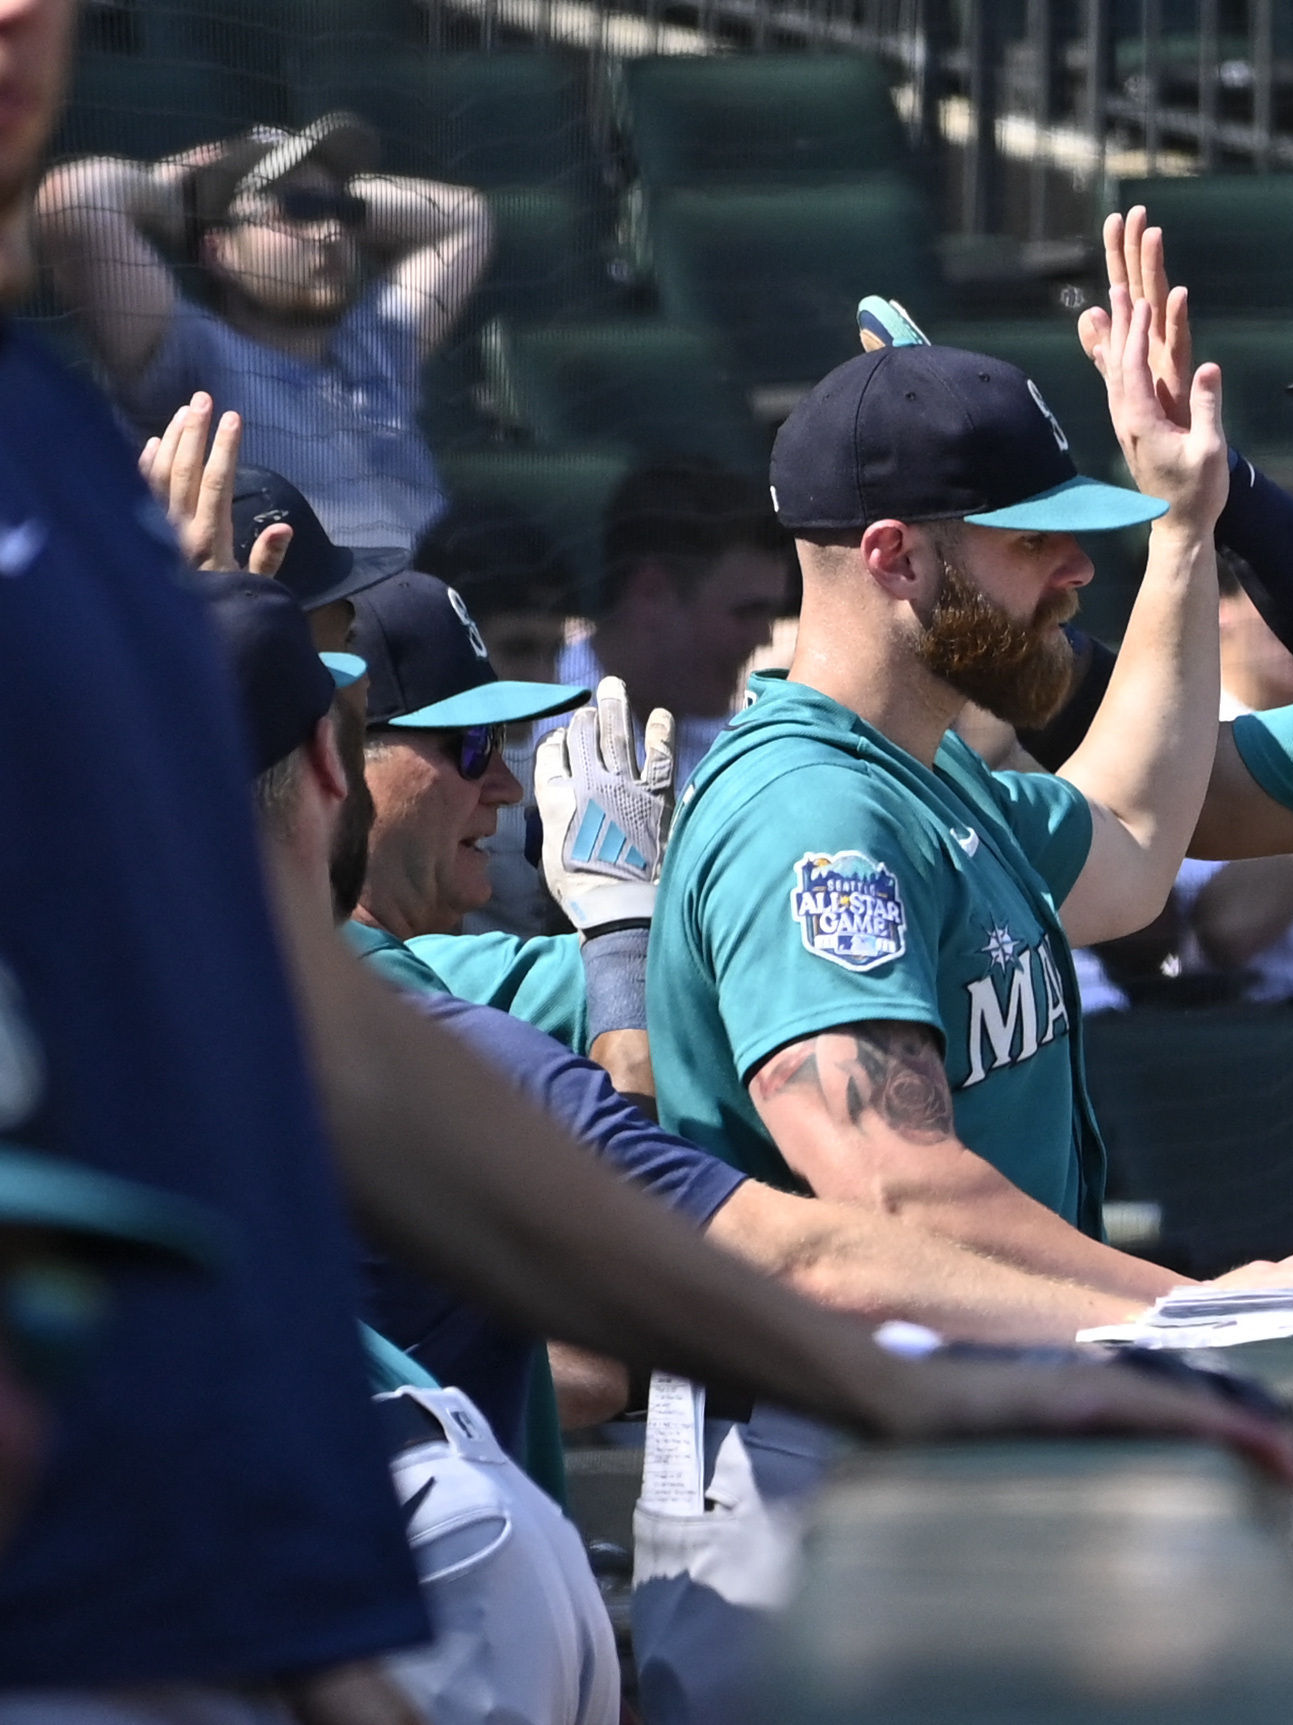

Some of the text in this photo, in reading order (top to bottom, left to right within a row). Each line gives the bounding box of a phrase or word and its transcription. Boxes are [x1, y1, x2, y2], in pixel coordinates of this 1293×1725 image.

[826, 878, 876, 897] SEATTLE
[798, 890, 902, 924] ALL STAR
[818, 908, 890, 937] GAME
